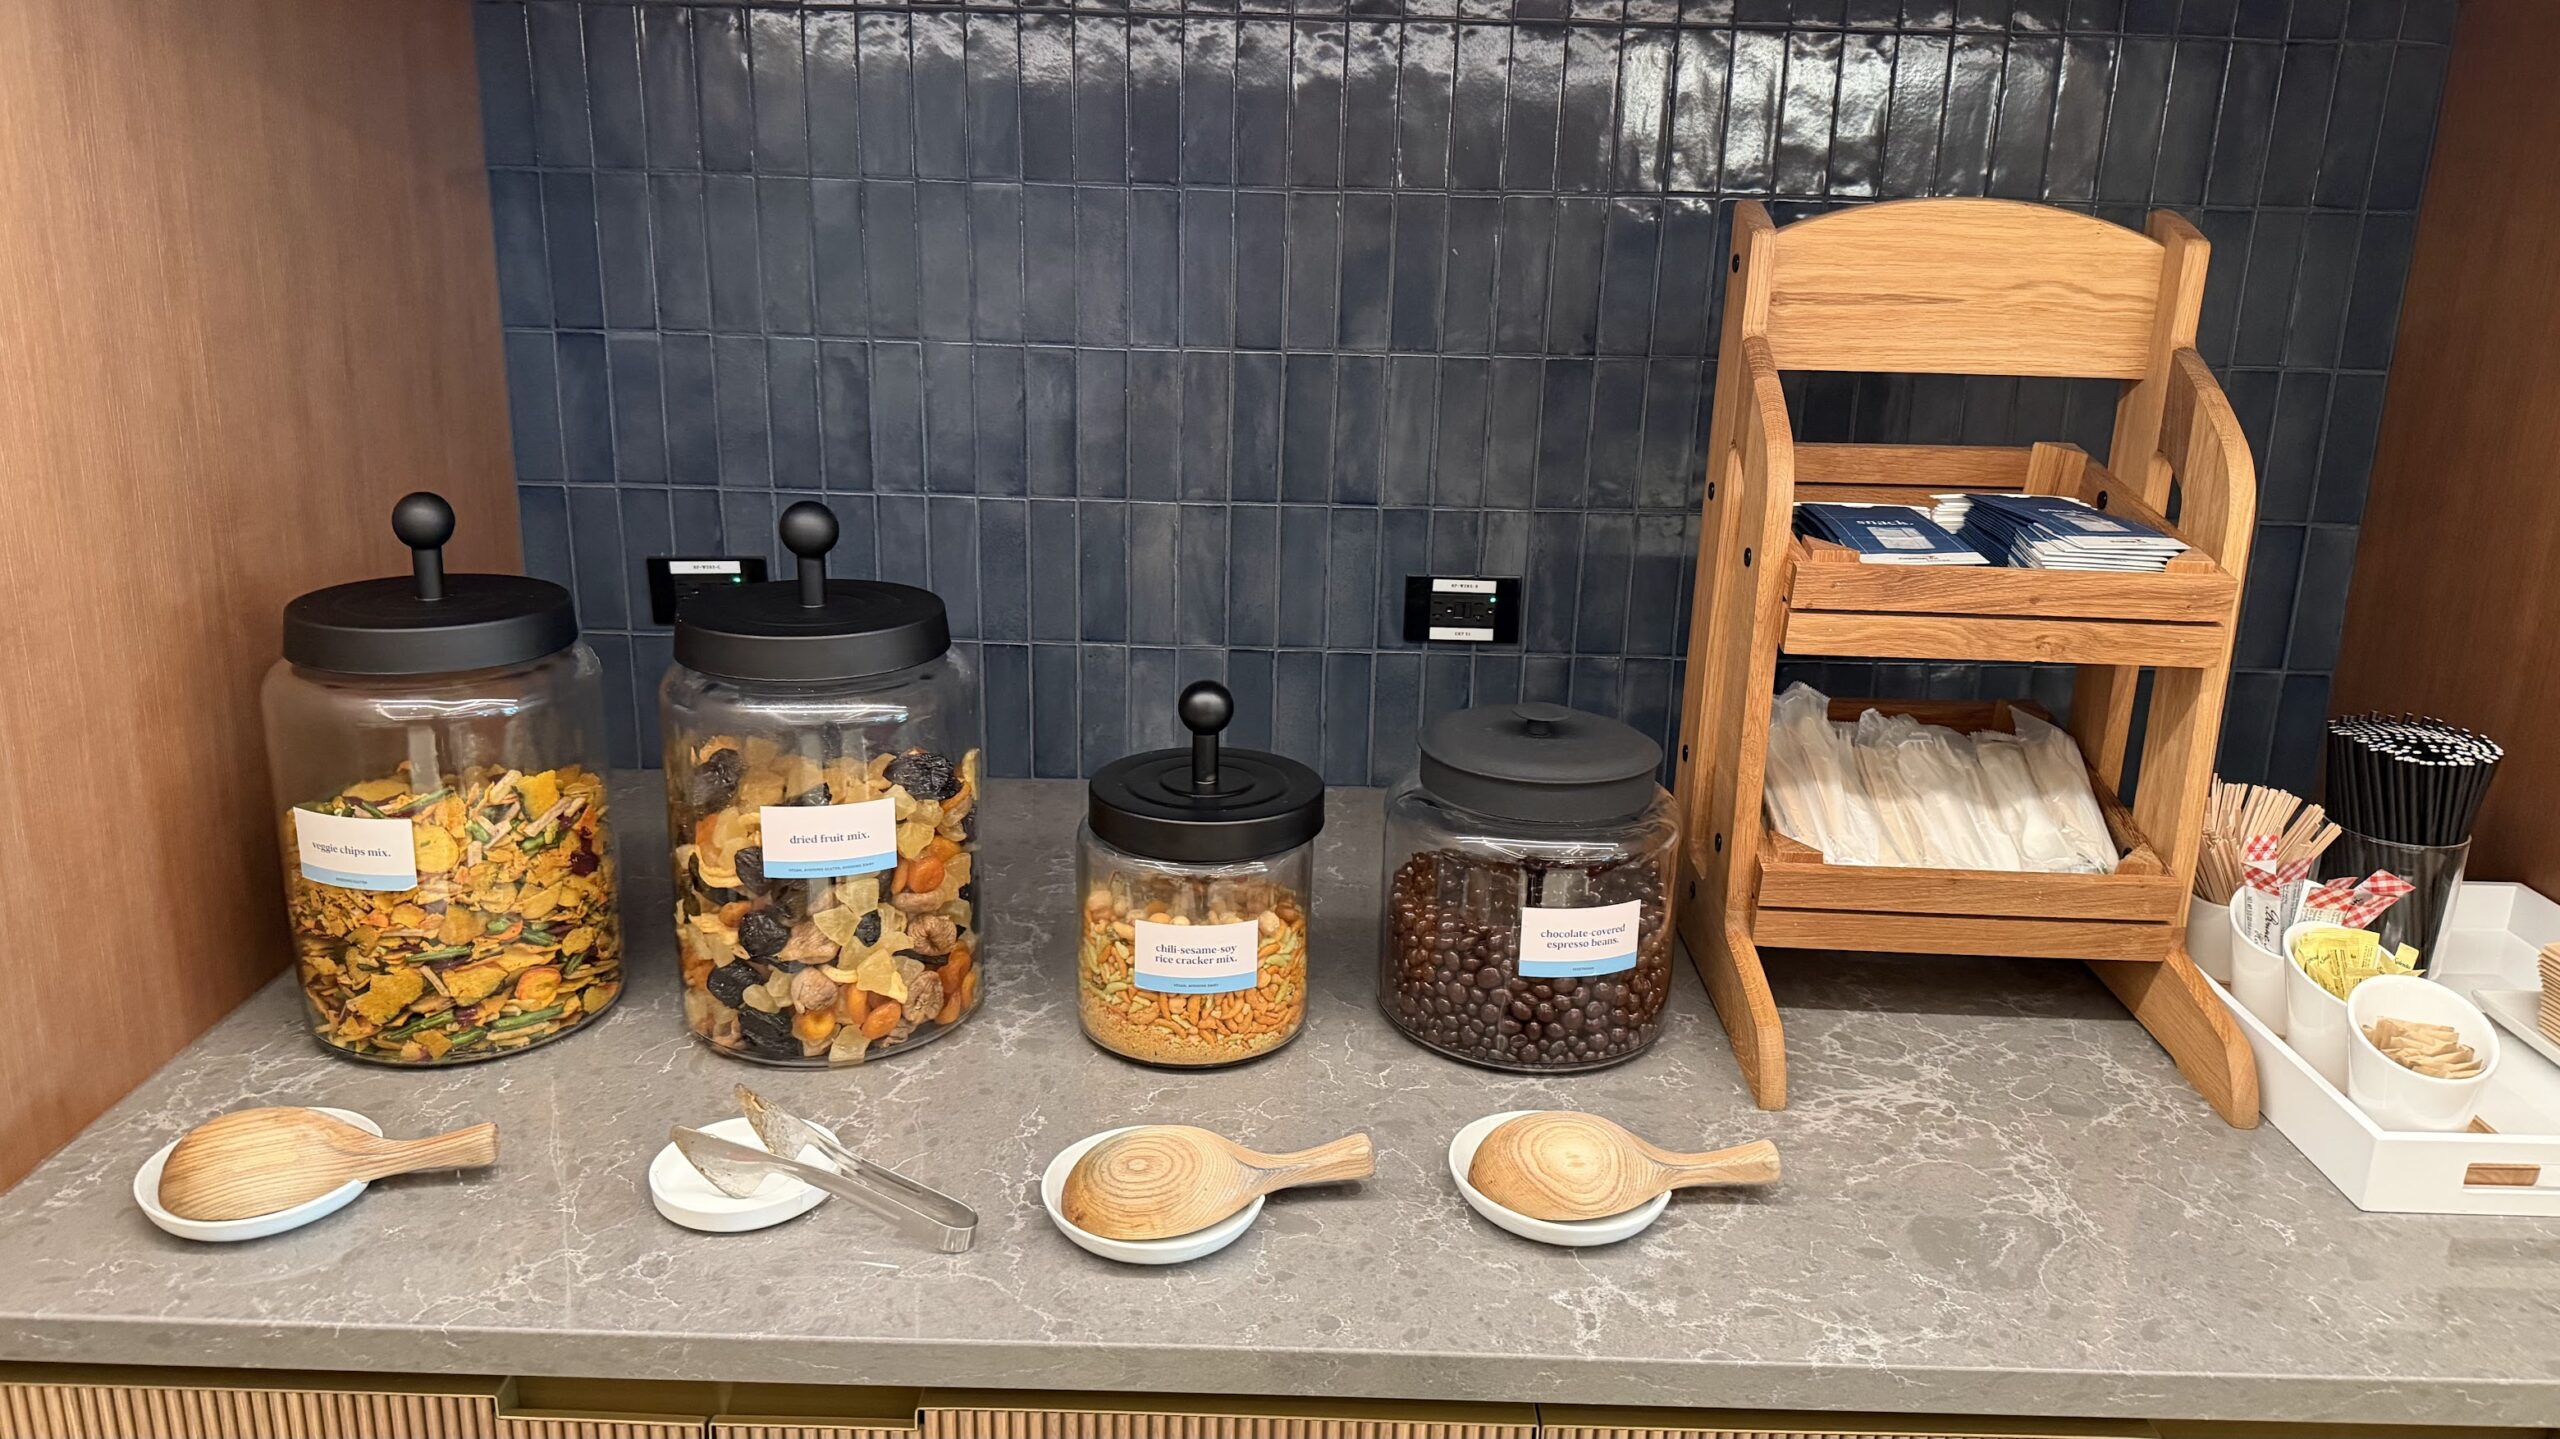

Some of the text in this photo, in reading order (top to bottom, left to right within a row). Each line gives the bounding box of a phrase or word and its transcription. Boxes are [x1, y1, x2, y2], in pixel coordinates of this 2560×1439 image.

[789, 831, 870, 844] dried fruit mix.
[312, 841, 391, 858] veggie chips mix.
[1540, 923, 1626, 939] chocolate-covered
[1155, 944, 1238, 955] chili-sesame-soy
[1546, 937, 1620, 951] espresso beans.
[1155, 954, 1238, 965] rice cracker mix.
